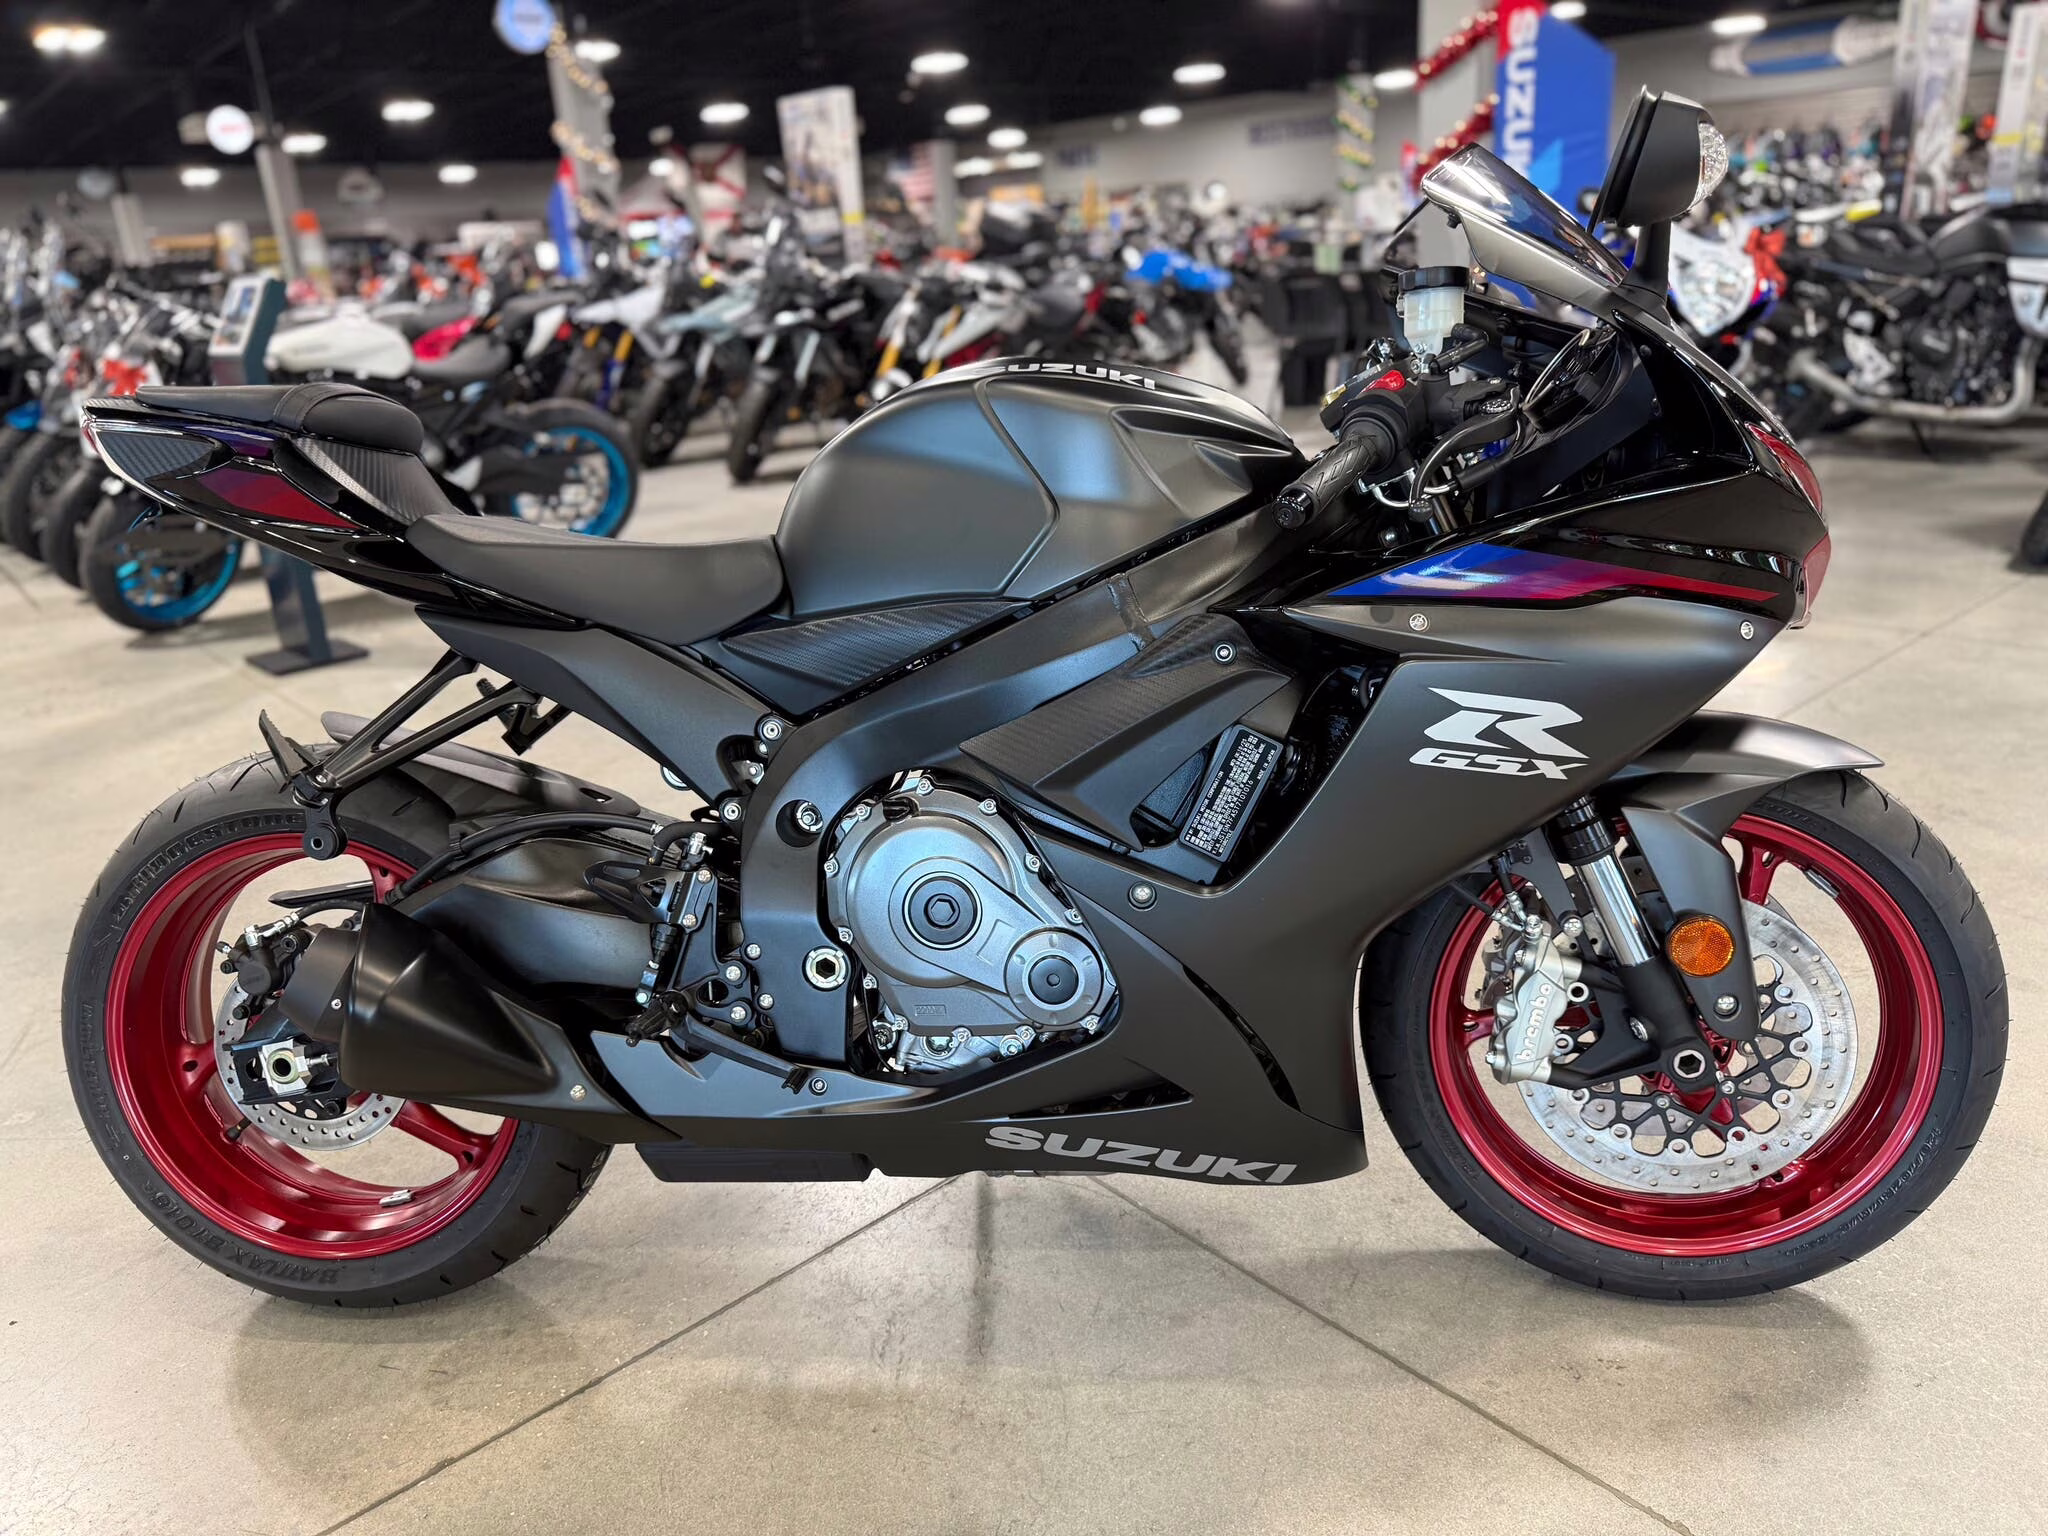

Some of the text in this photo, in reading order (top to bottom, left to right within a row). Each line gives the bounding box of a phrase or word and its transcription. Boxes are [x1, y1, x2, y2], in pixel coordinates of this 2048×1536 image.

[1423, 686, 1590, 759] R
[1409, 747, 1589, 780] GSX
[1515, 983, 1552, 1060] brembo
[985, 1126, 1298, 1184] SUZUKI
